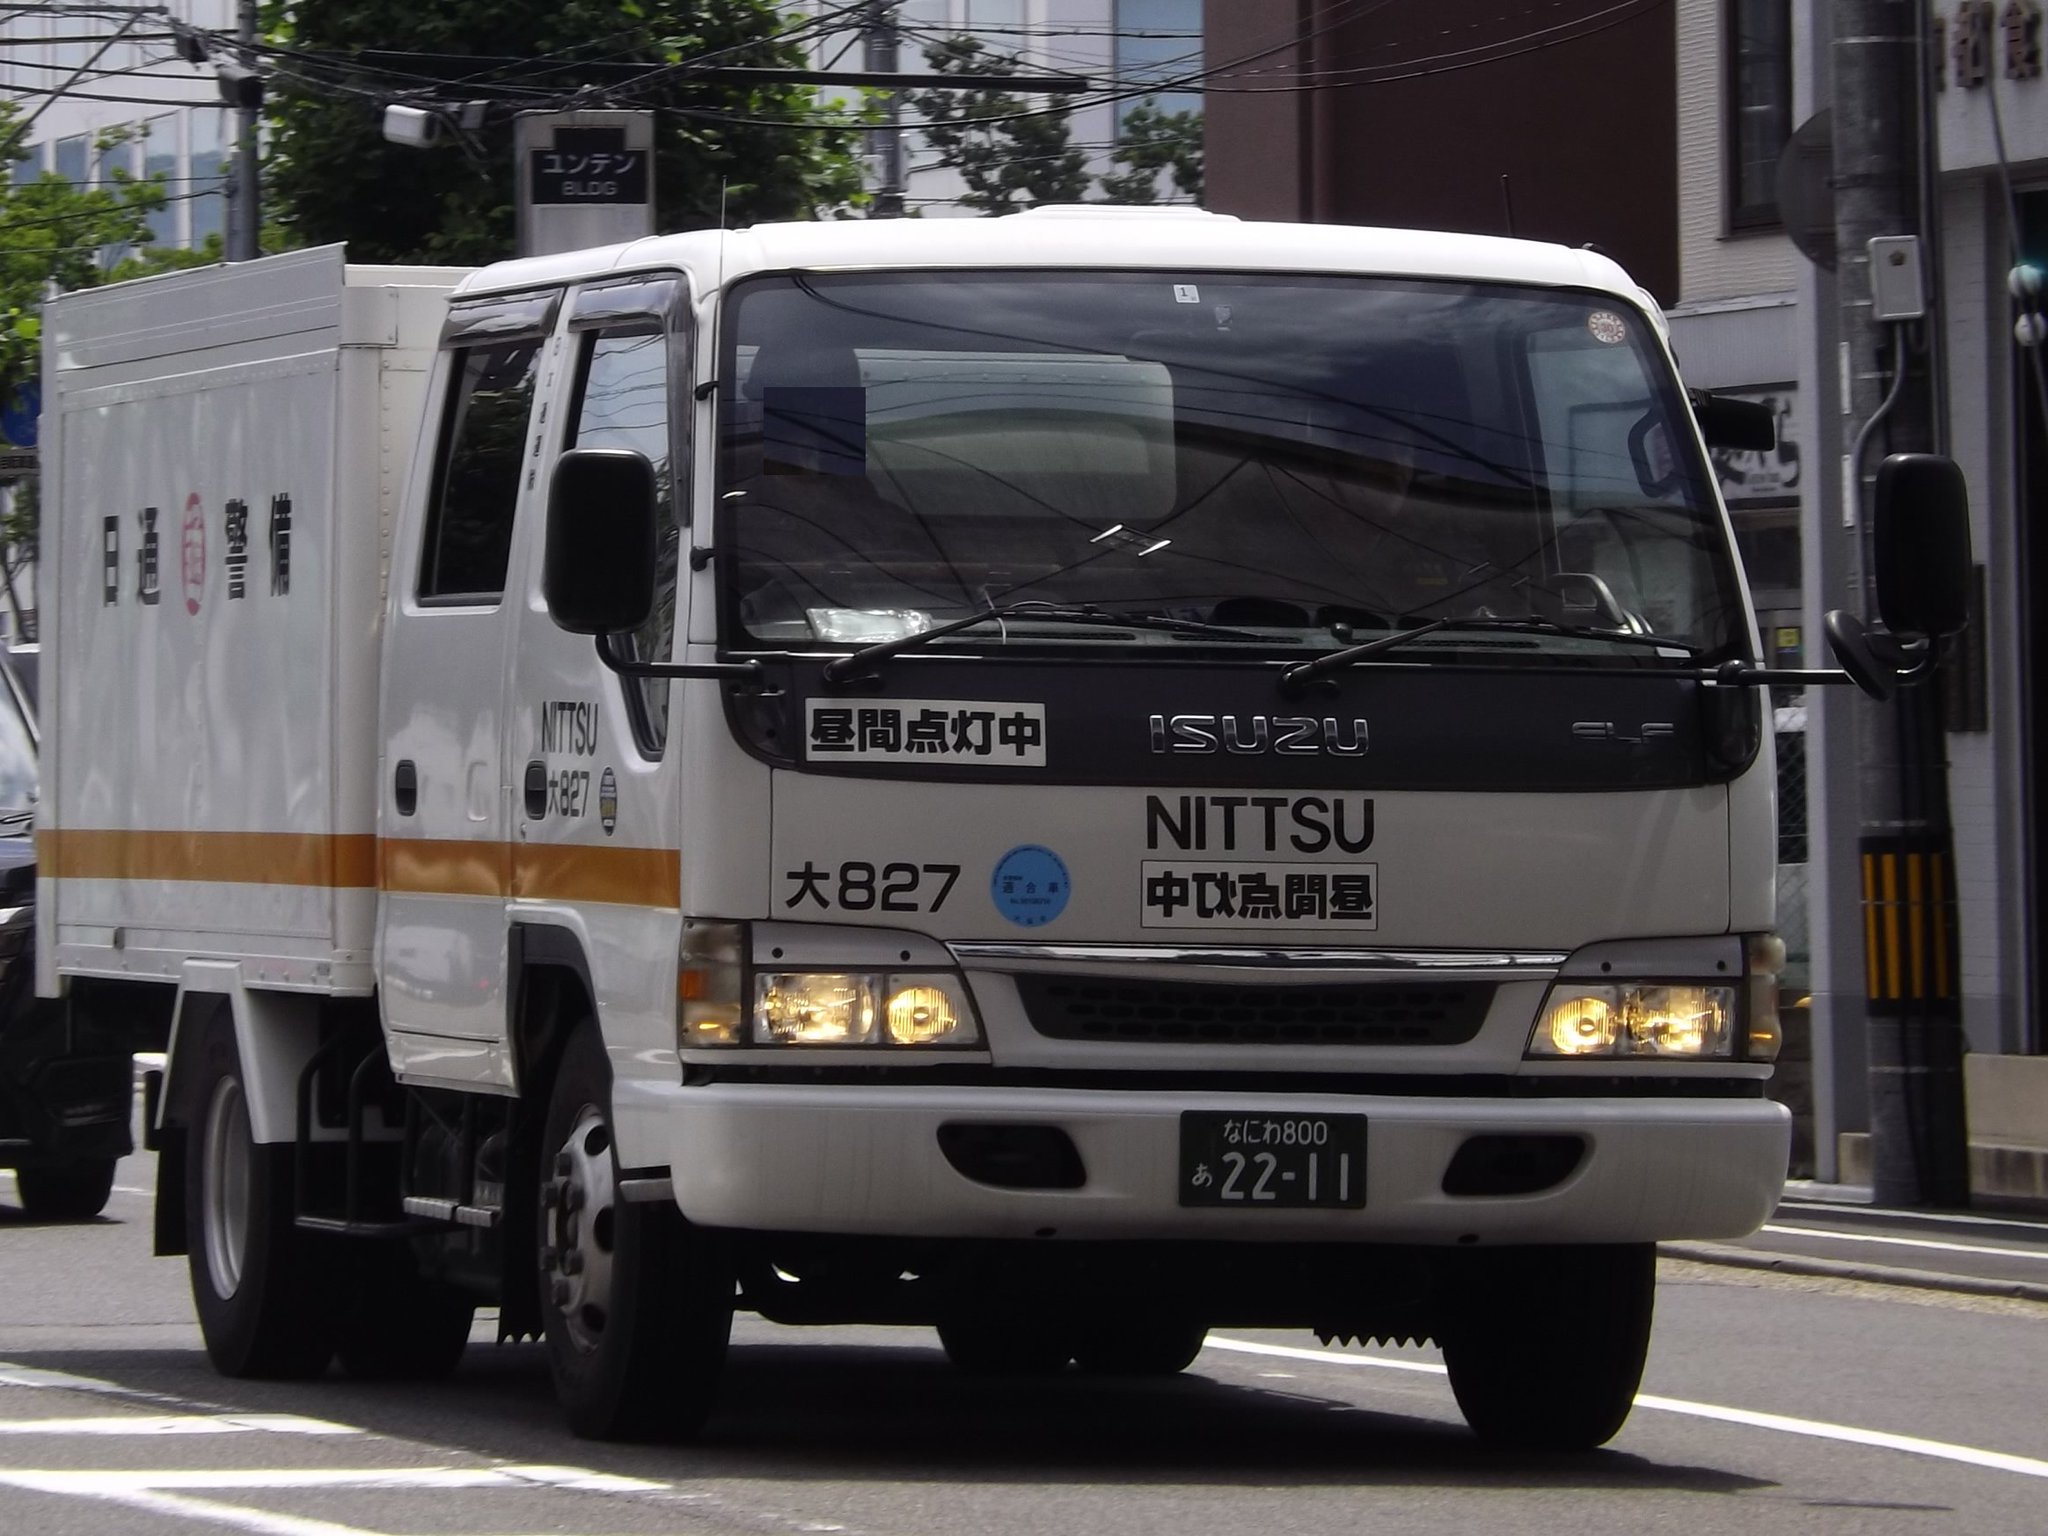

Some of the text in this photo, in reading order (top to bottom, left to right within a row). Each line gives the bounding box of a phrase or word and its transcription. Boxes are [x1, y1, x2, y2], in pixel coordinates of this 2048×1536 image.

[542, 153, 636, 174] ユンテン
[562, 181, 617, 196] BLDG
[541, 701, 599, 757] NITTSU
[810, 708, 1041, 757] 昼間点灯中
[1149, 714, 1370, 757] ISUZU
[548, 769, 590, 818] 大827
[1146, 795, 1375, 854] NITTSU
[785, 860, 962, 914] 大827
[1191, 1151, 1349, 1201] あ 22-11
